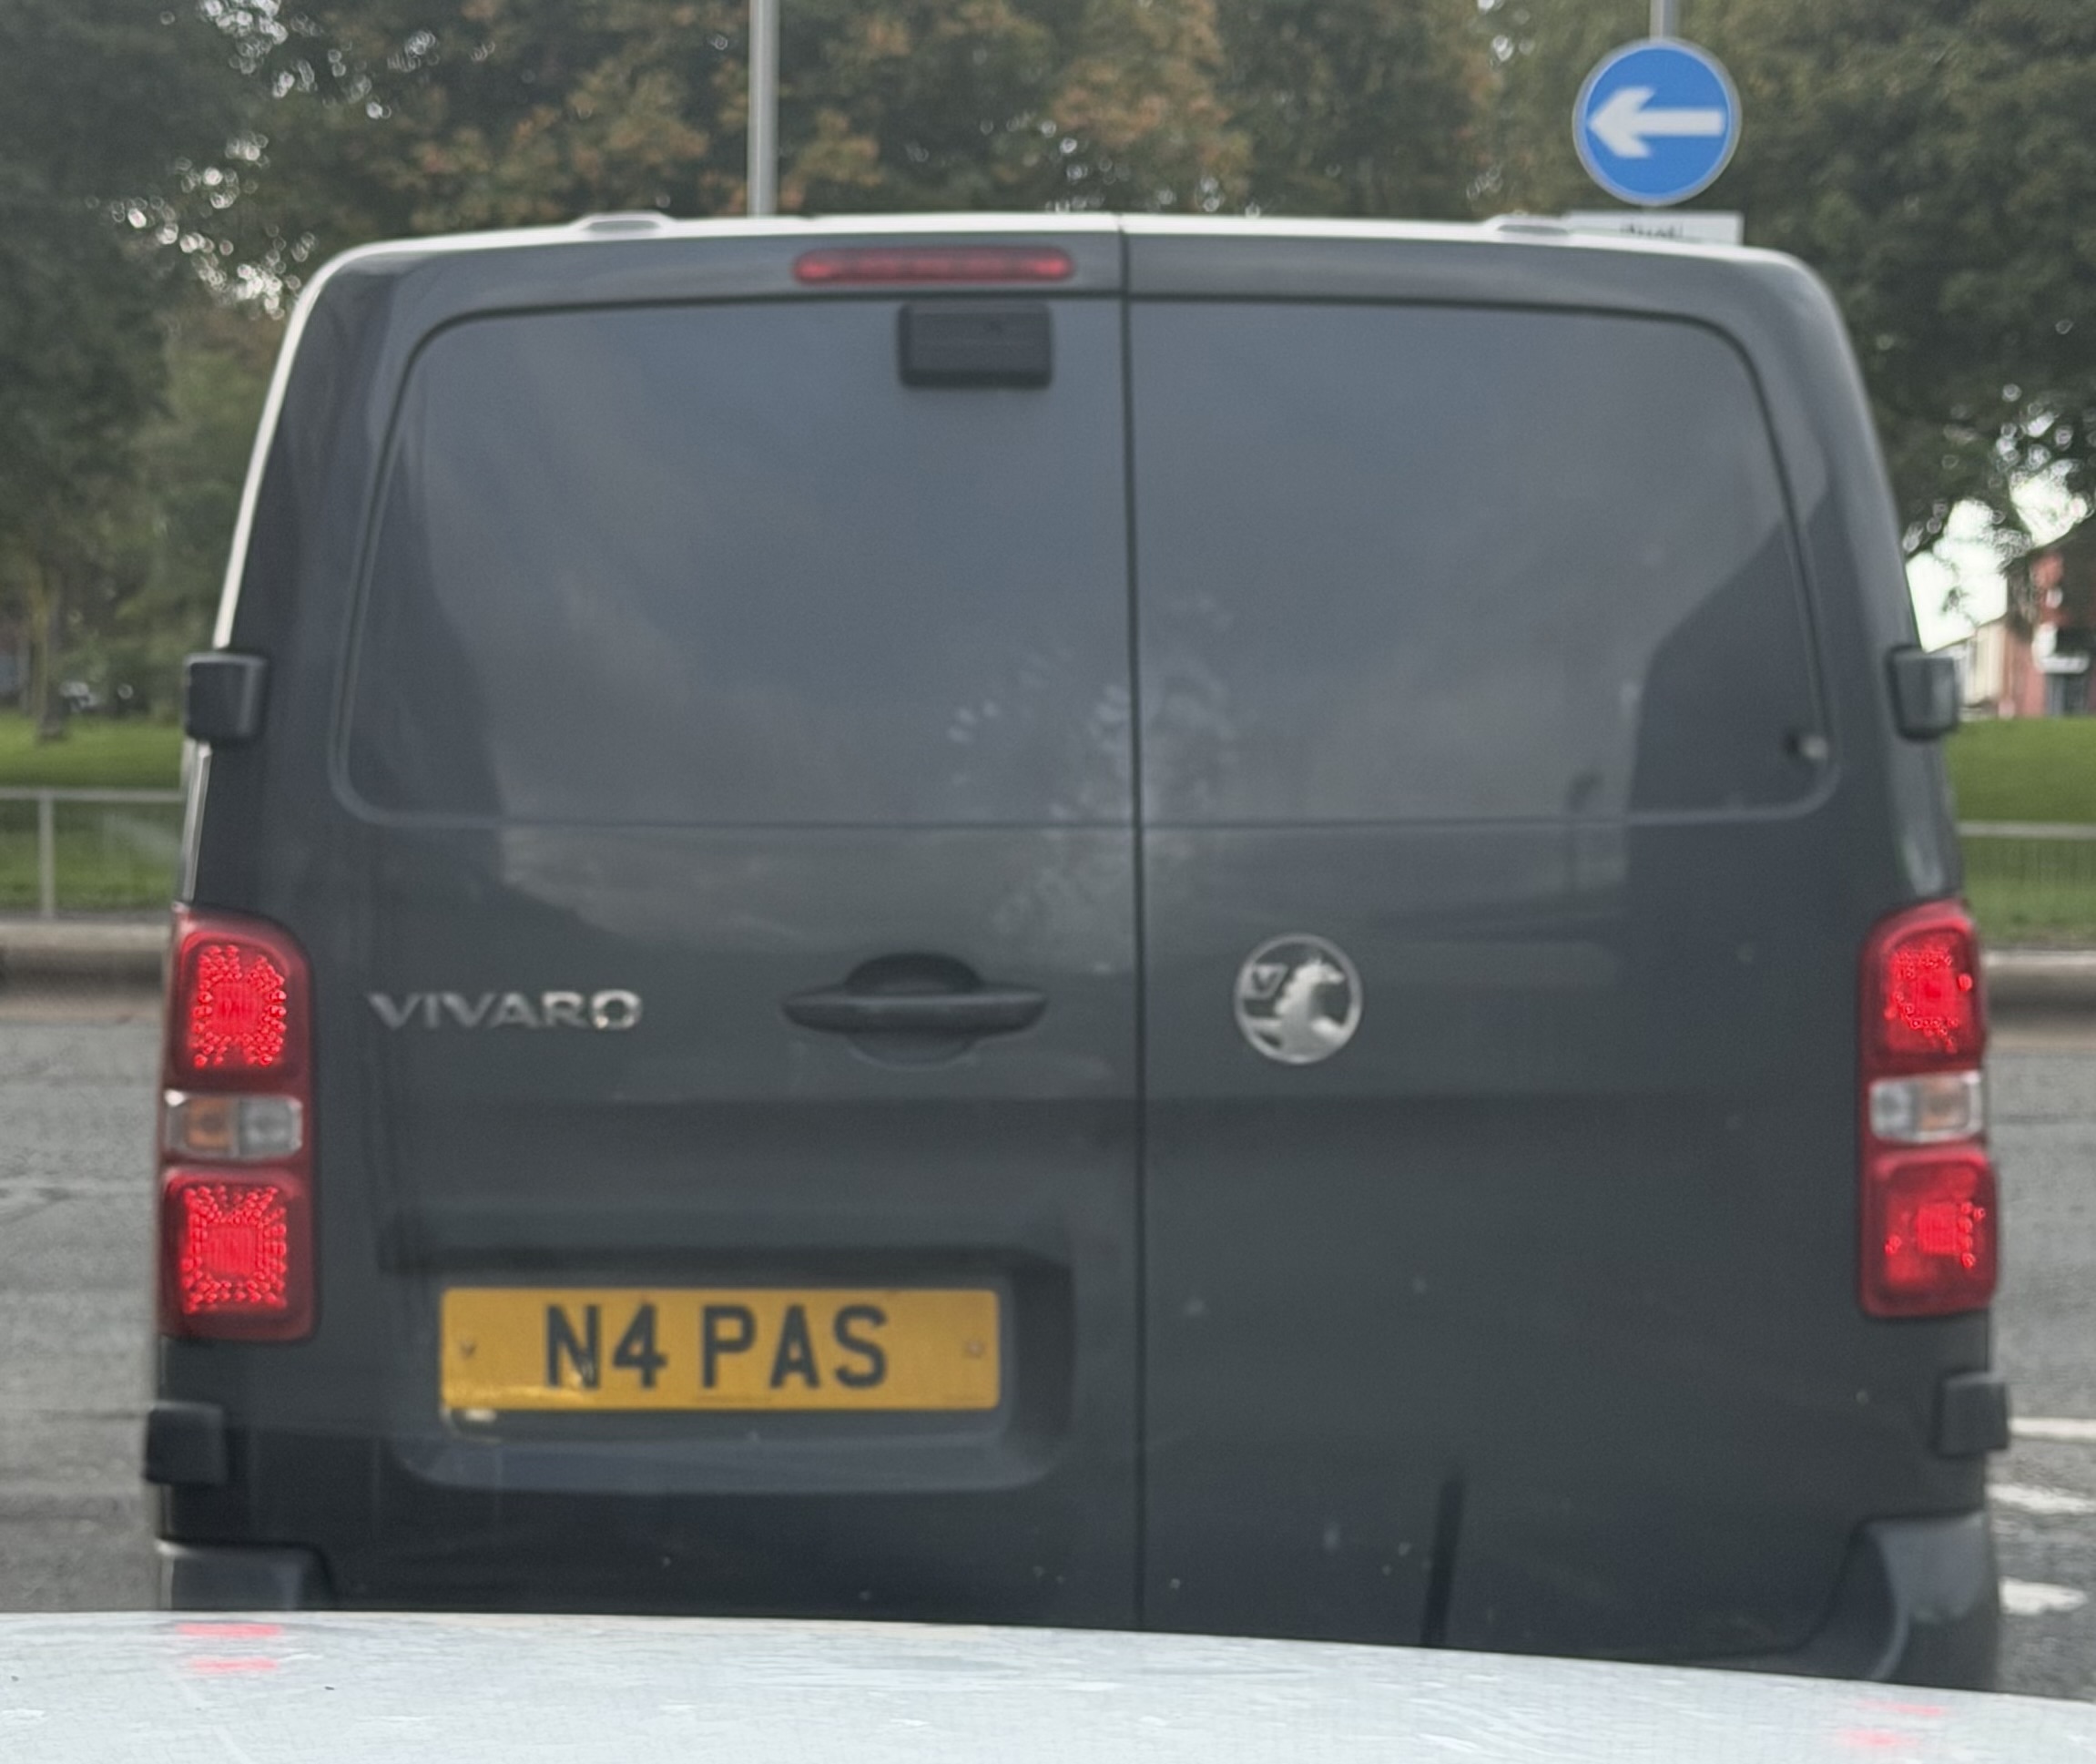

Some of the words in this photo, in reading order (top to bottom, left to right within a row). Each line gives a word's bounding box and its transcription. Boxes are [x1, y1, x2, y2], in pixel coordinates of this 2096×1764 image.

[366, 989, 643, 1031] VIVARO
[546, 1303, 668, 1389] N4
[701, 1304, 889, 1389] PAS
